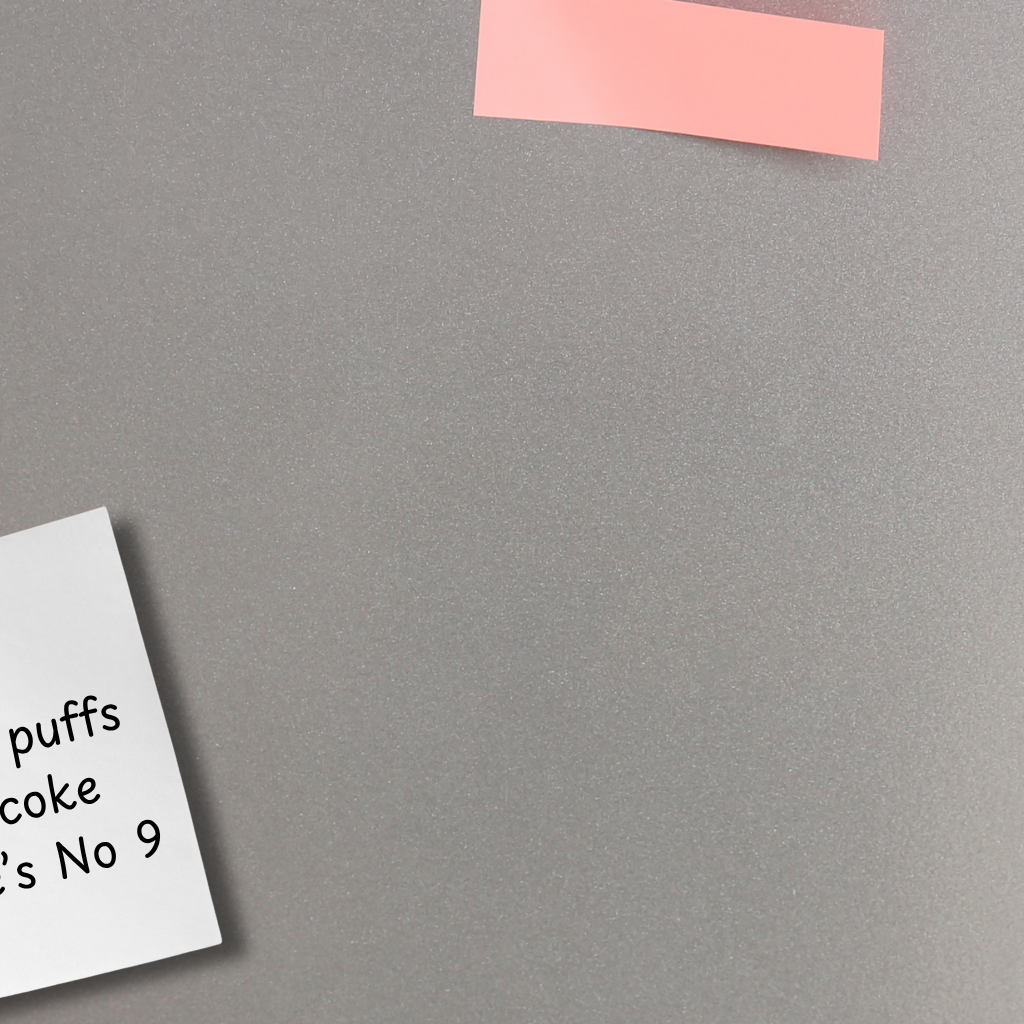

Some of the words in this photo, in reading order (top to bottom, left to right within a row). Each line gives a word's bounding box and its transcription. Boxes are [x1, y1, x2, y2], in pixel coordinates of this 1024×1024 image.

[8, 695, 121, 769] puffs
[0, 773, 101, 825] coke
[55, 836, 117, 880] No
[136, 819, 162, 859] 9
